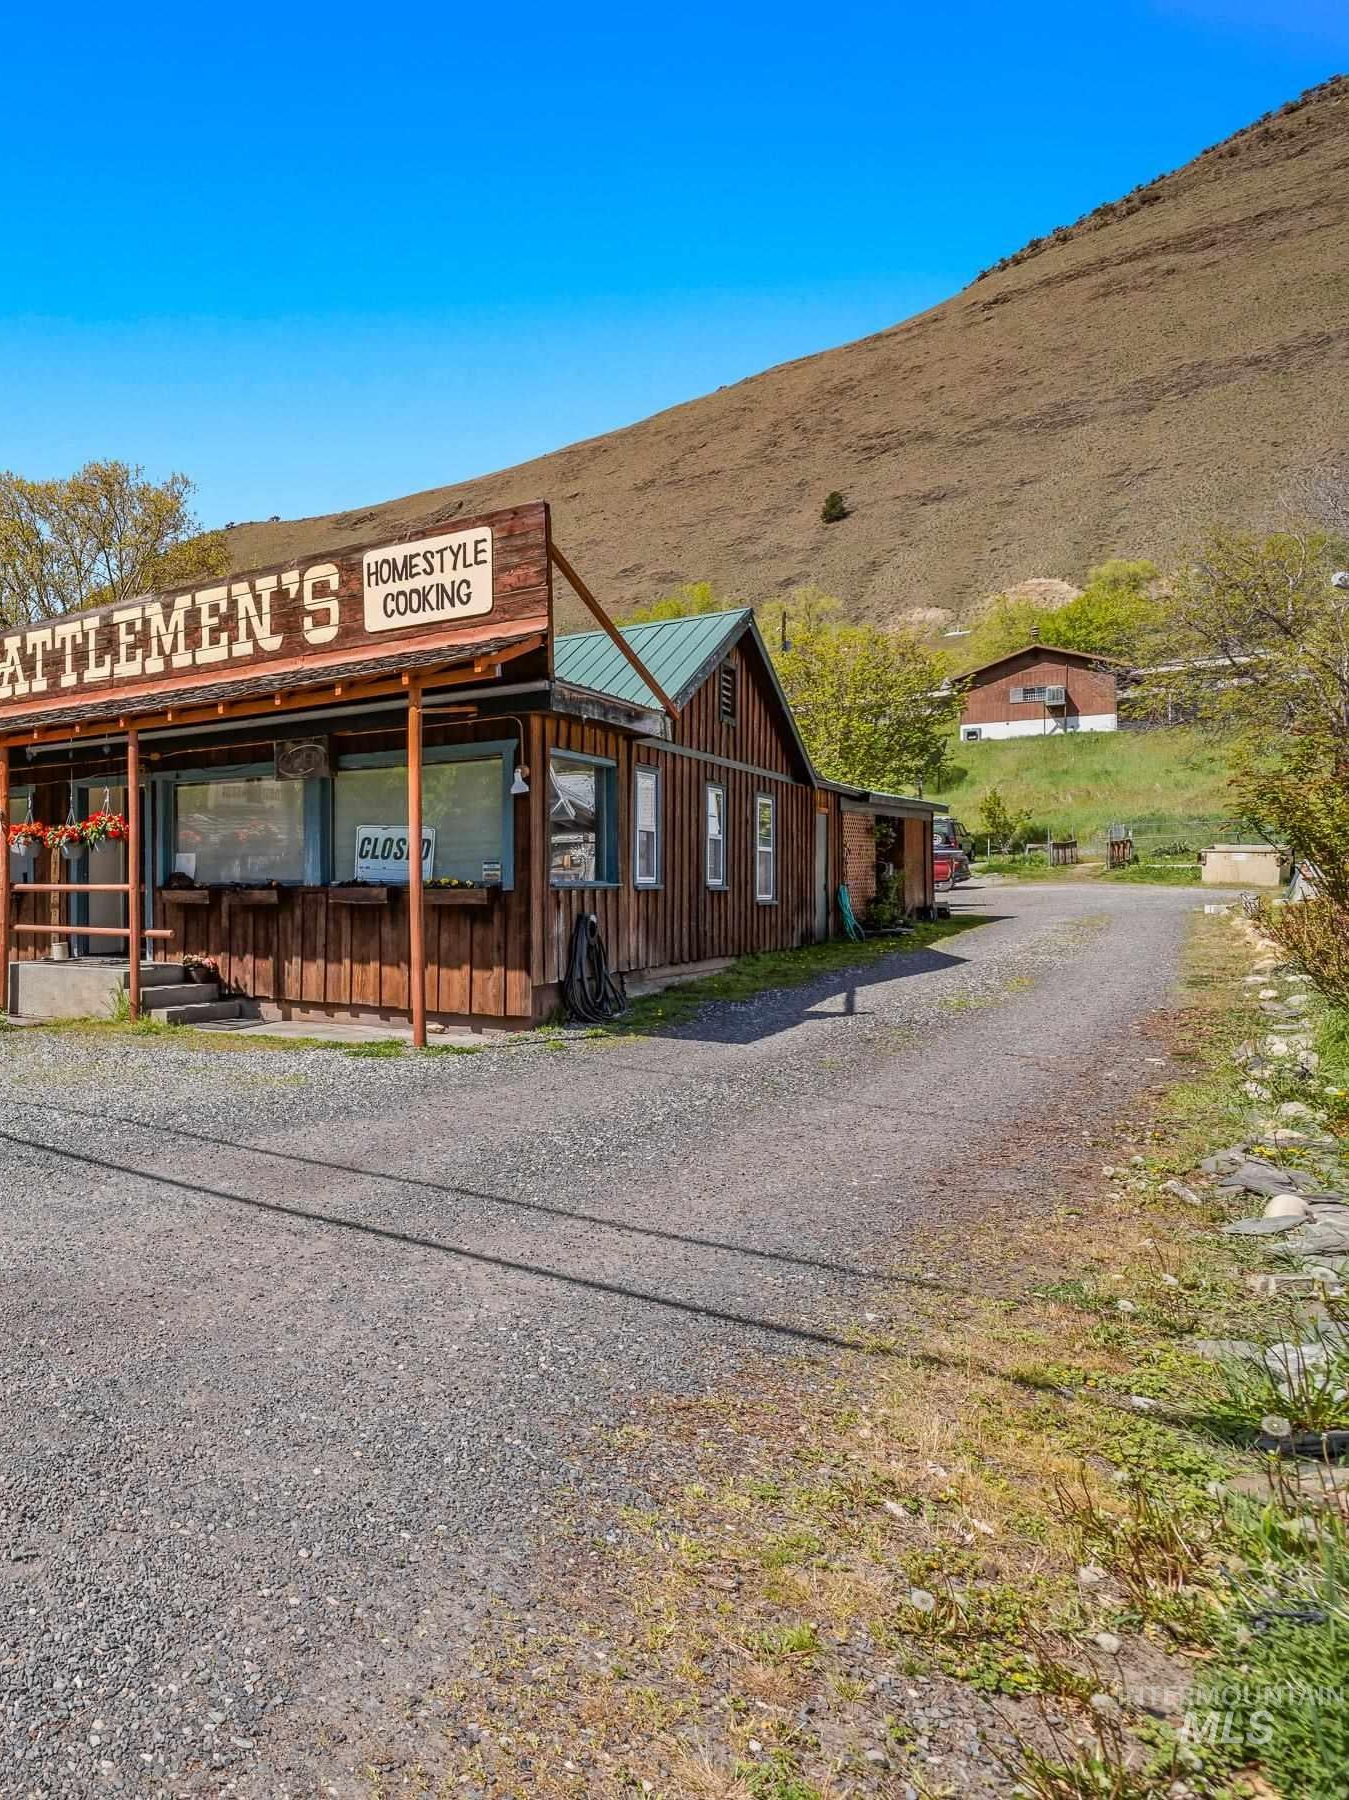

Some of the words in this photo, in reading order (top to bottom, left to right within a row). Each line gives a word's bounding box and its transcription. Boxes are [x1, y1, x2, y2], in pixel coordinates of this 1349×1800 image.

[366, 538, 488, 588] HOMESTYLE
[383, 578, 472, 618] COOKING
[358, 836, 432, 861] CLOSD
